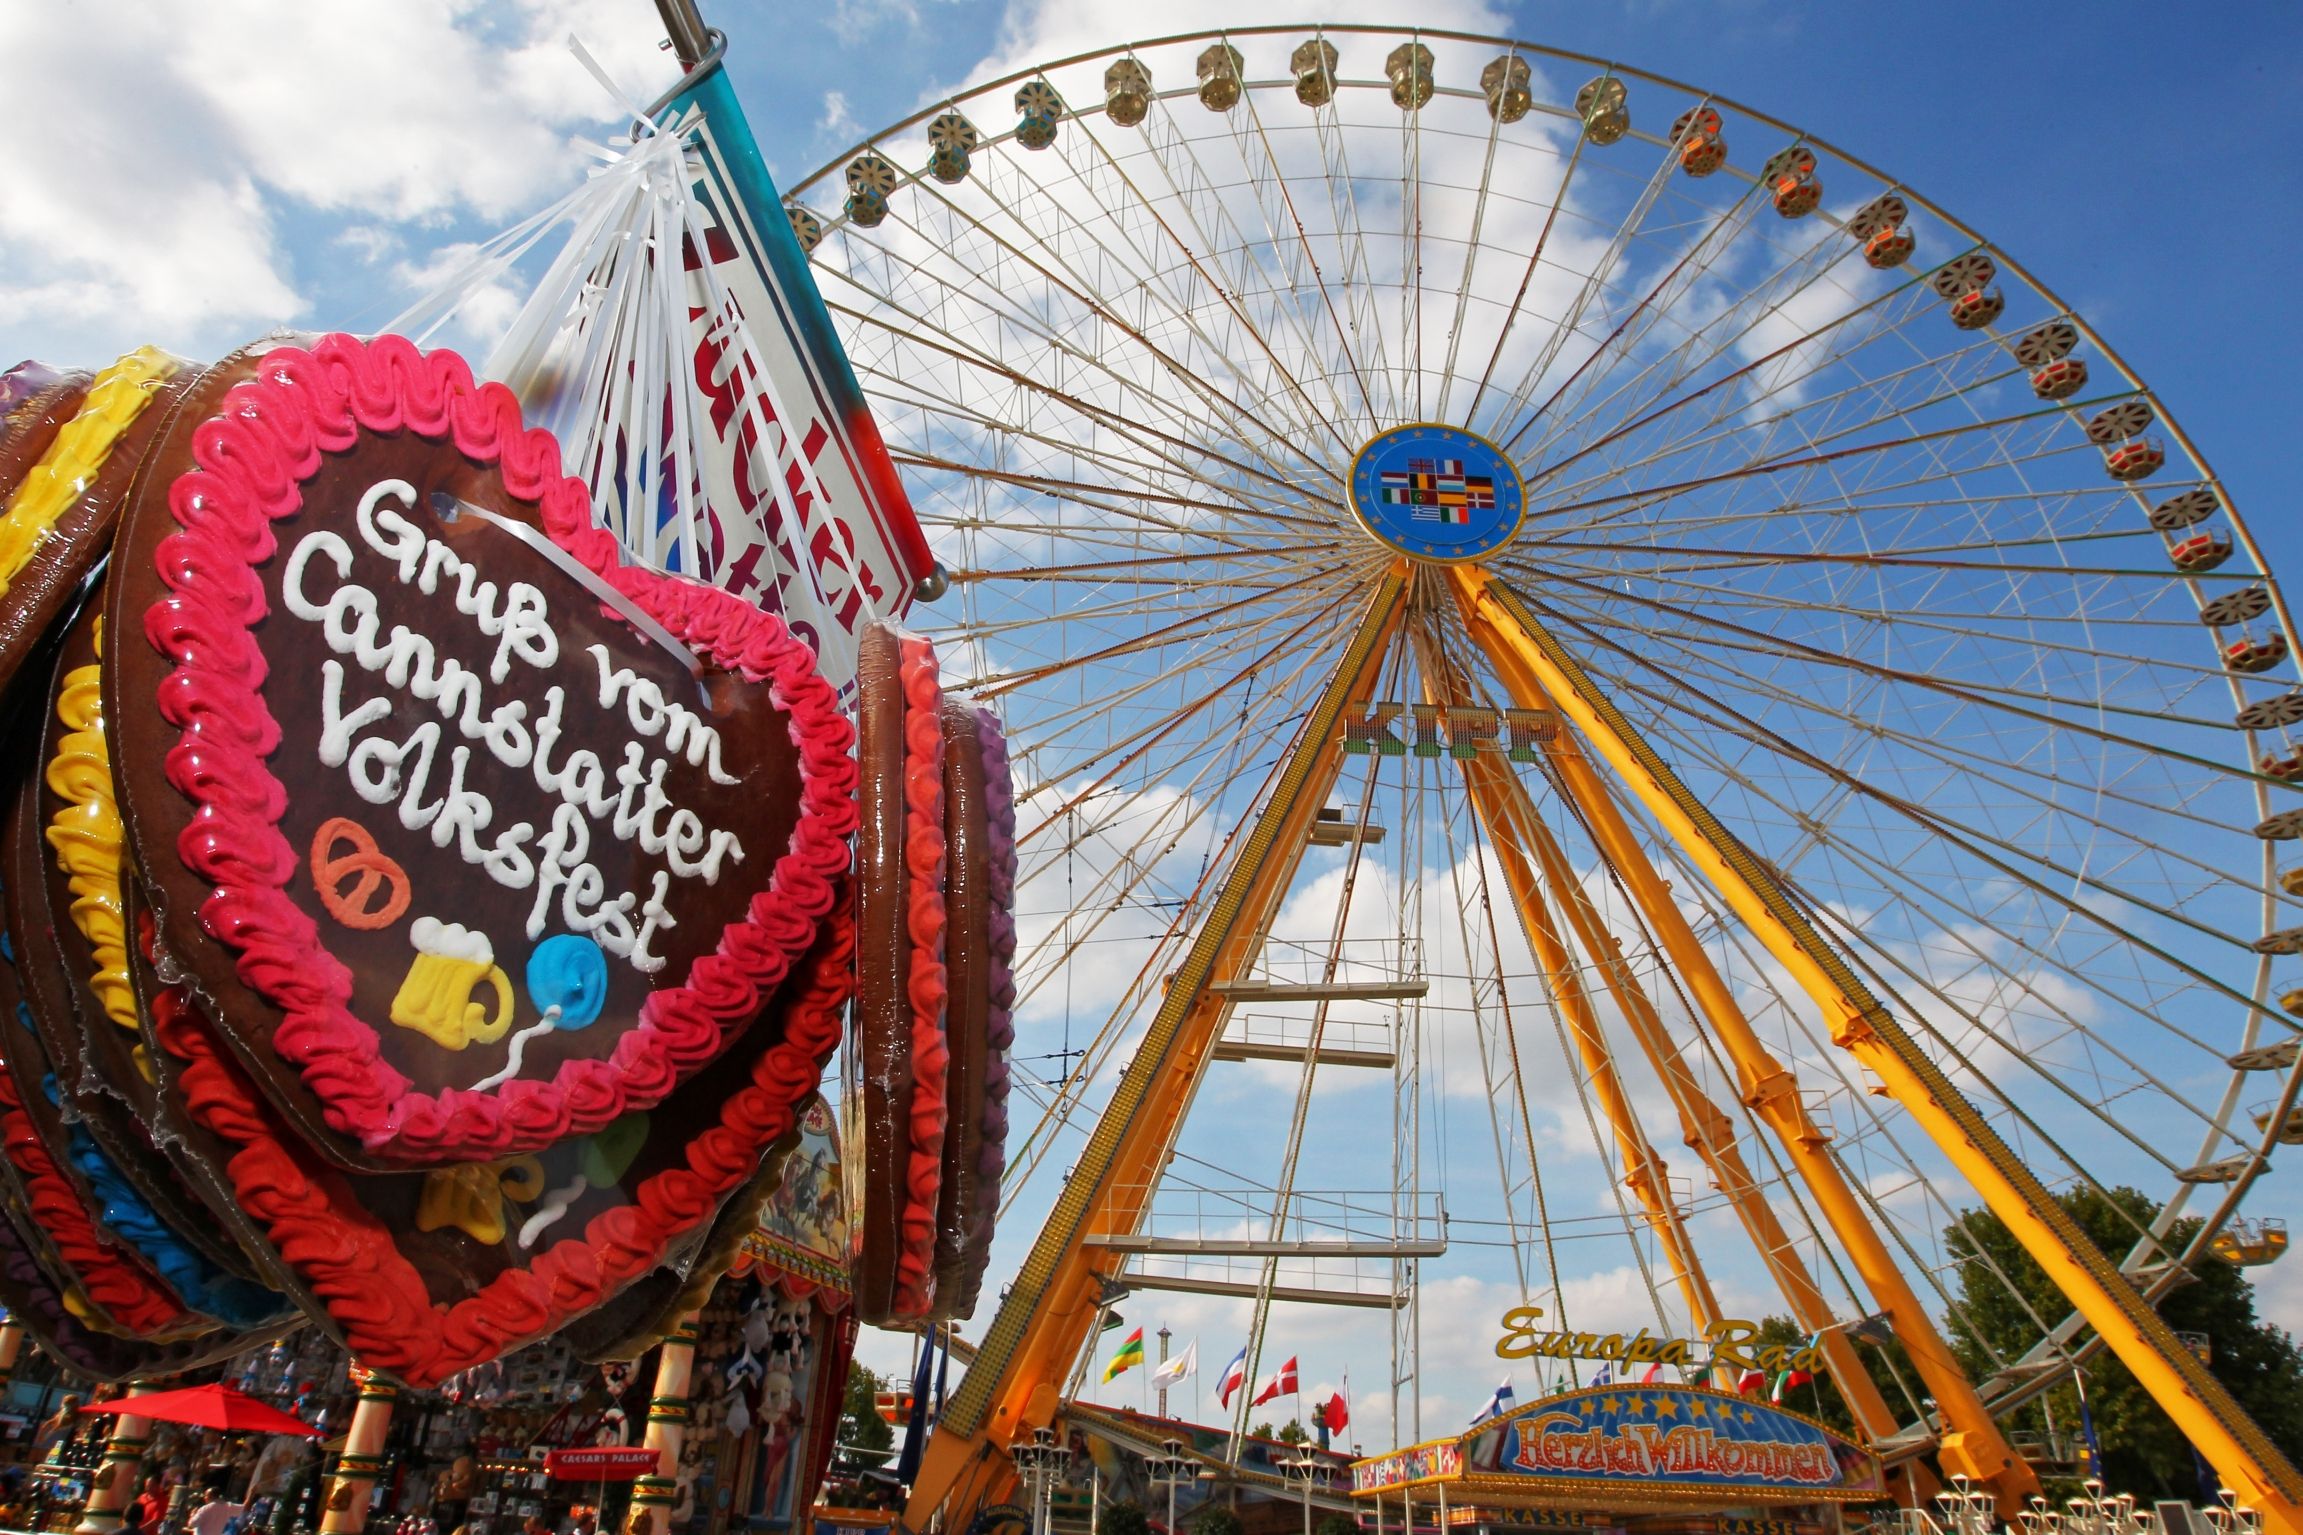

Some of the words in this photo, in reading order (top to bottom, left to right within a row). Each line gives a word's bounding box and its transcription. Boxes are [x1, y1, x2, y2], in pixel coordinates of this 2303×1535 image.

[356, 479, 559, 684] Gruß
[283, 531, 745, 885] Cannstatter
[1342, 702, 1559, 762] KIPP
[319, 660, 677, 972] Volksfest
[1496, 1306, 1694, 1376] Europa
[1700, 1319, 1824, 1374] Rad
[561, 1454, 605, 1463] CAESARS
[612, 1454, 650, 1463] PALACE
[1513, 1412, 1645, 1476] Herzlich
[1637, 1422, 1835, 1484] Willkommen
[1503, 1507, 1581, 1526] KASSE
[1717, 1518, 1793, 1535] KASSE
